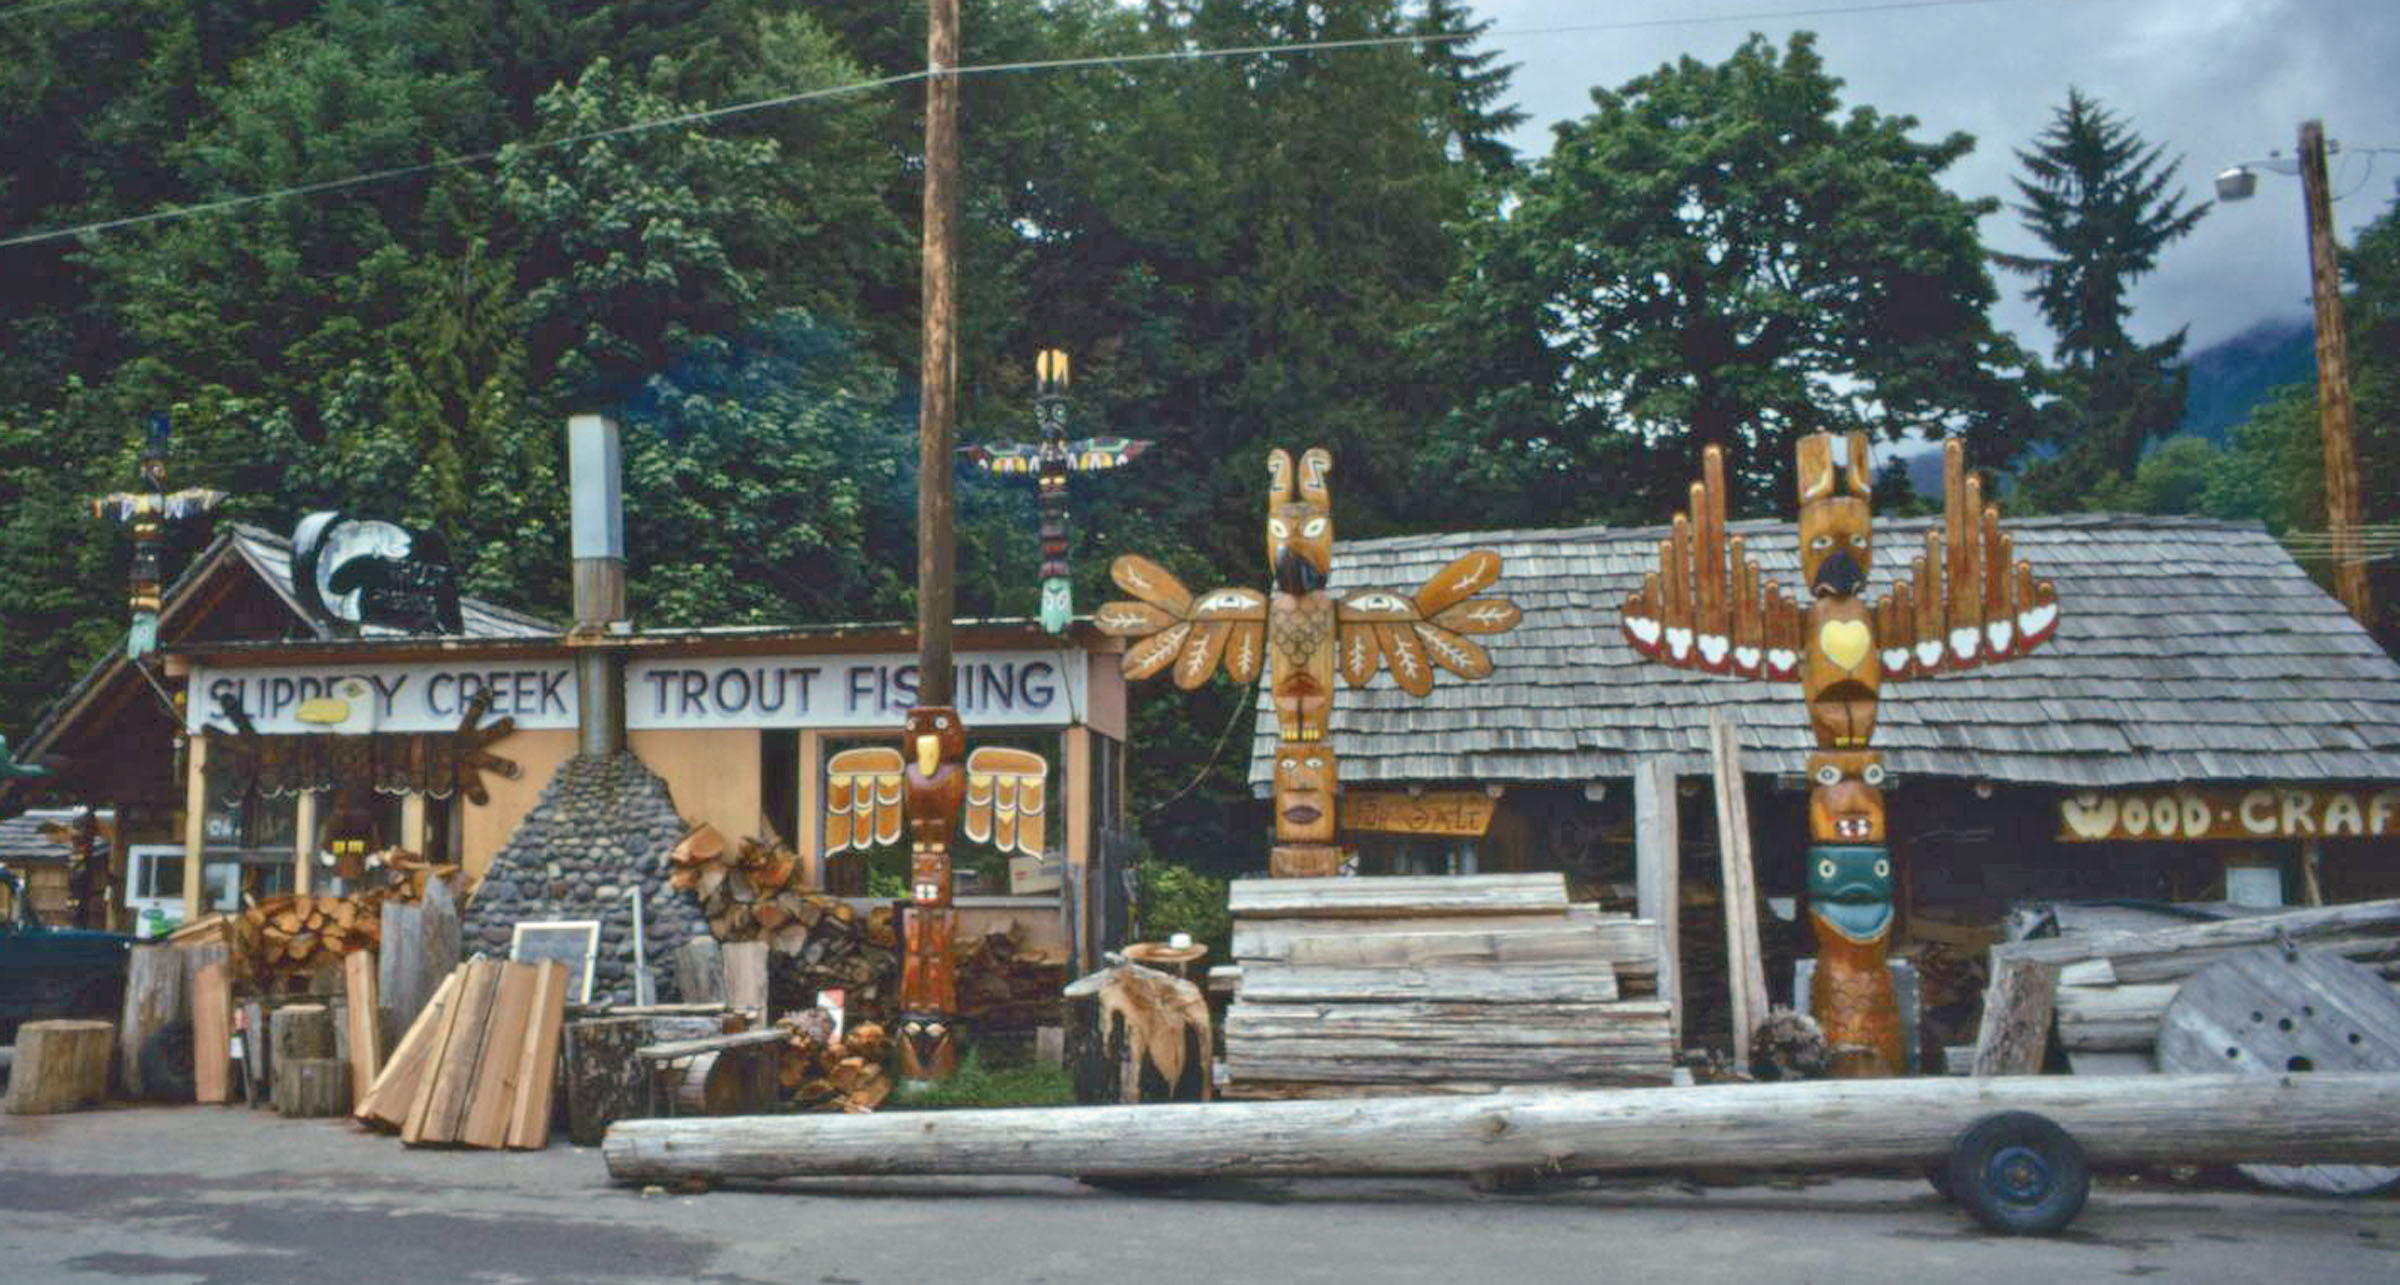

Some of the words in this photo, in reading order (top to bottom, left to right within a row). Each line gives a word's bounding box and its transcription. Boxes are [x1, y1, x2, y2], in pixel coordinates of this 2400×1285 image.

[210, 674, 408, 720] SLIPPY
[428, 670, 568, 718] CREEK
[646, 666, 821, 716] TROUT
[849, 661, 1054, 713] FISING
[2061, 796, 2212, 839] WOOD
[2239, 788, 2400, 837] CRAF
